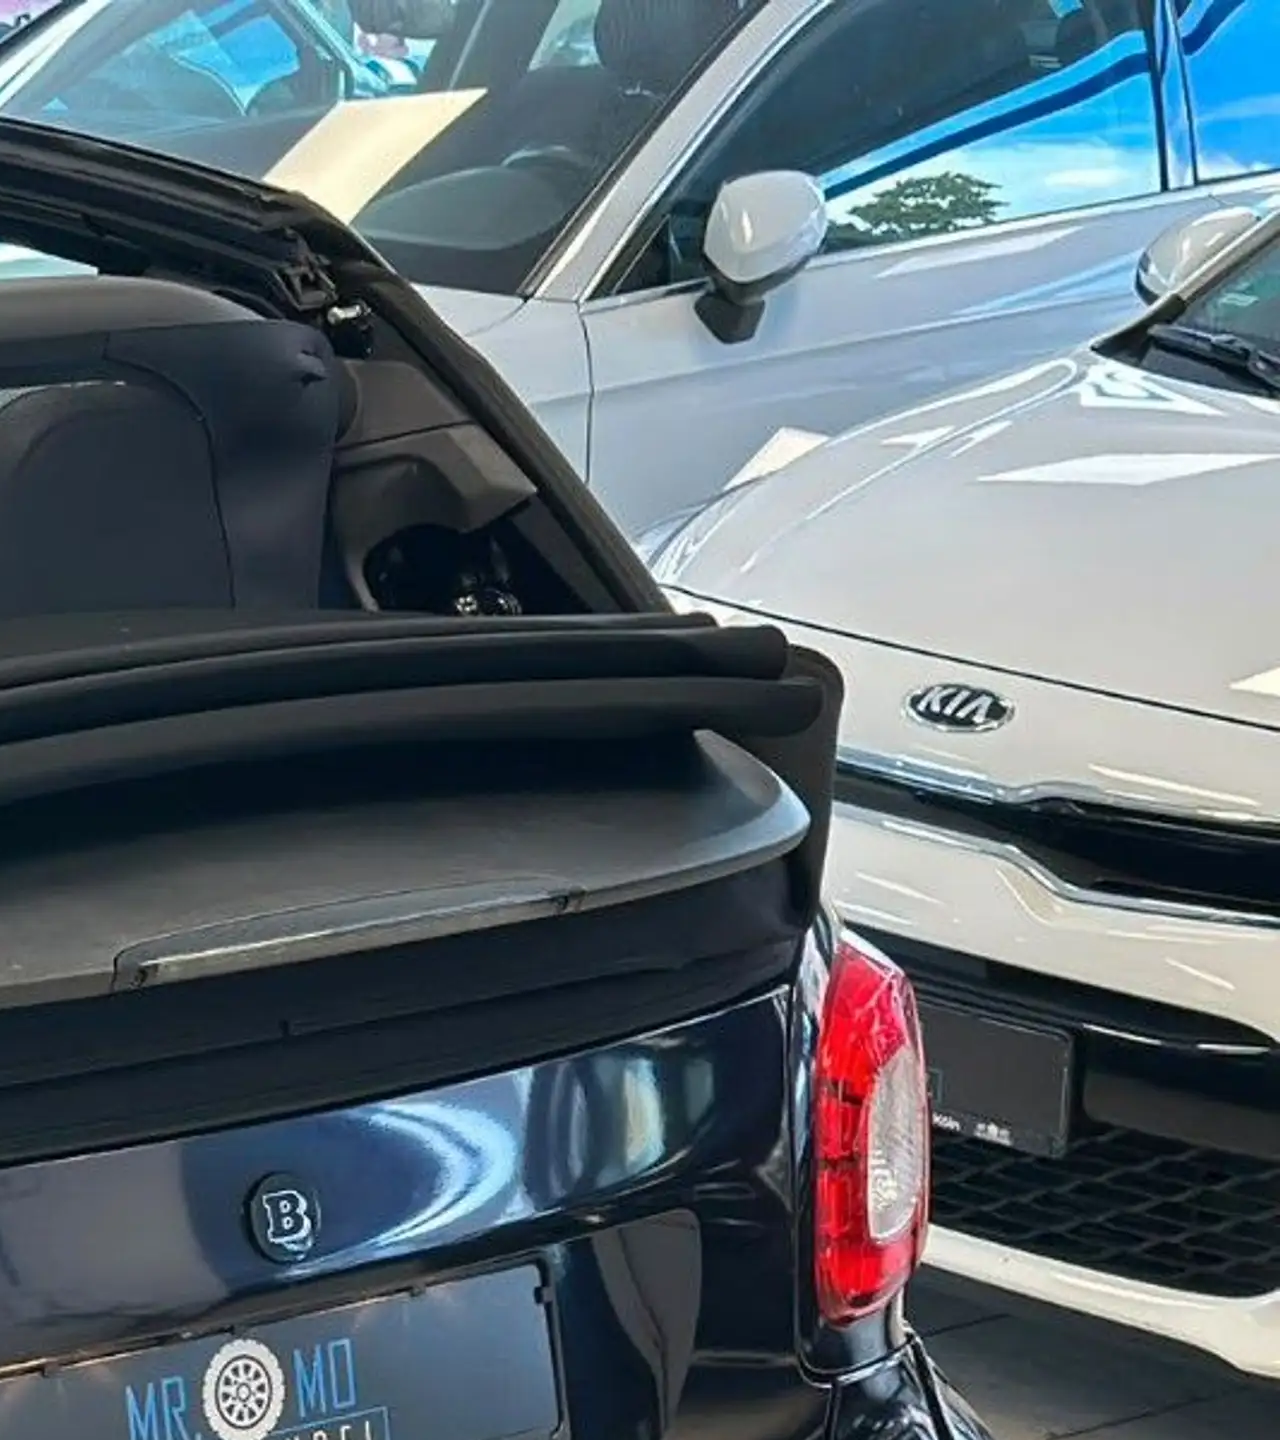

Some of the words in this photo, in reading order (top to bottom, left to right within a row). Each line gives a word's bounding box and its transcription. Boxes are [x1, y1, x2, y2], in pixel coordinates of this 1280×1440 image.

[916, 686, 993, 724] KIA
[262, 1190, 311, 1244] B
[293, 1338, 356, 1418] MO
